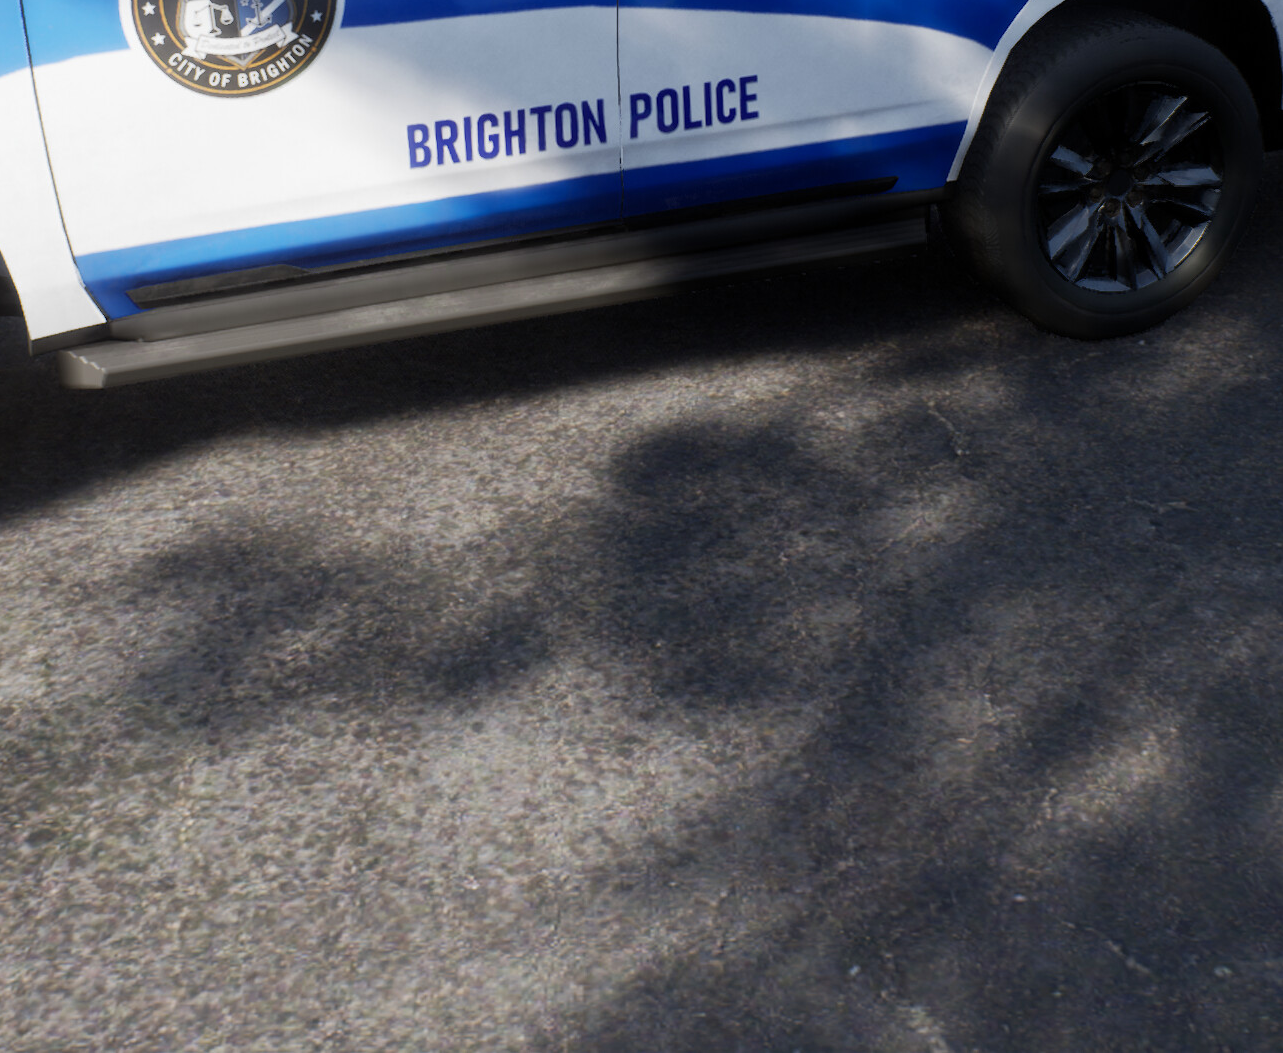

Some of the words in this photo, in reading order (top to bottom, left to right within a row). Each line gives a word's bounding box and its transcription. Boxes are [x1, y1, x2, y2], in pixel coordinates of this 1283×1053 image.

[168, 52, 206, 81] CITY
[208, 72, 232, 88] OF
[237, 34, 314, 88] BRIGHTON
[407, 98, 607, 169] BRIGHTON
[629, 75, 759, 139] POLICE
